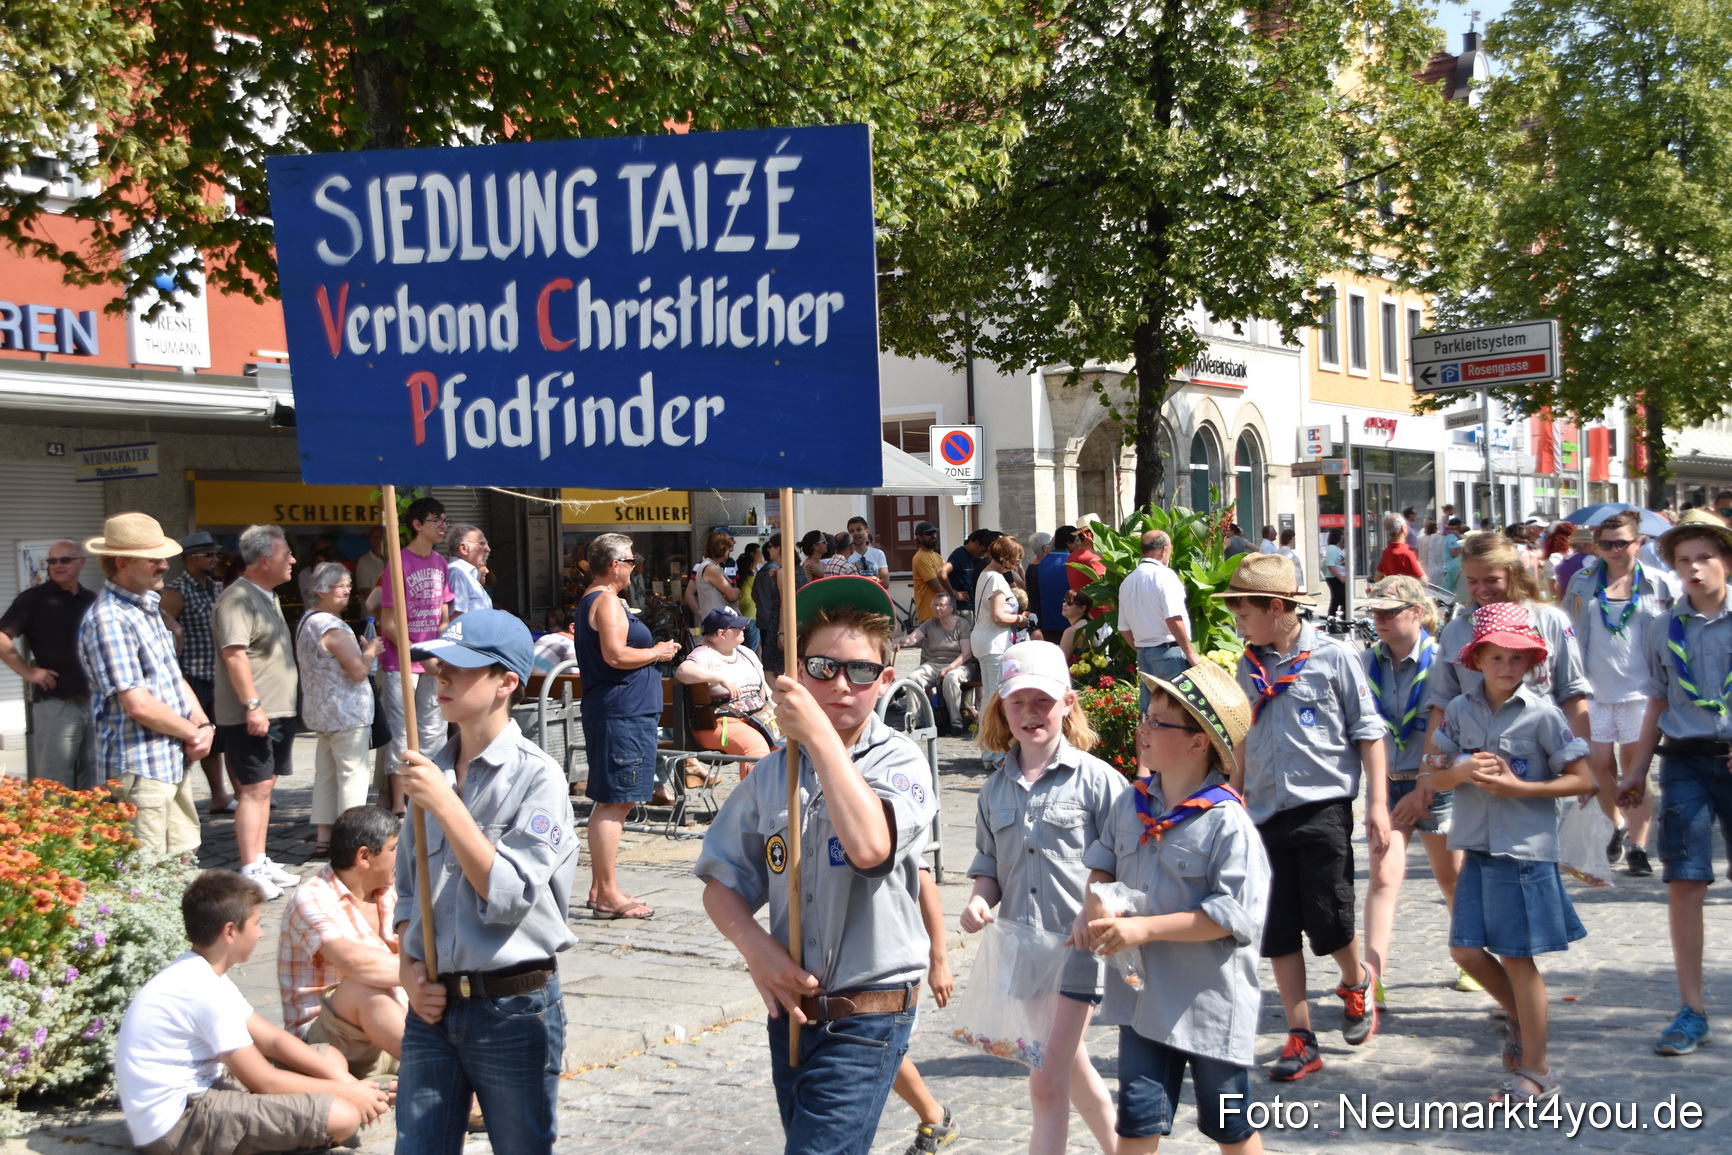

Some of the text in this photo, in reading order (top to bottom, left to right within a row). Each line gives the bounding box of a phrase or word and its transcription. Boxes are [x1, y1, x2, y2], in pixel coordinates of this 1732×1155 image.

[314, 136, 802, 267] SIEDLUNG TAIZÉ
[316, 273, 845, 359] Verband Christlicher
[145, 338, 201, 357] THUMANN
[1434, 333, 1526, 356] Parkleitsystem
[1468, 360, 1529, 377] Rosengasse
[405, 370, 726, 461] Pfadfinder
[48, 443, 64, 456] 41
[83, 448, 150, 466] NEUMARKTER
[944, 467, 971, 477] ZONE
[274, 504, 380, 522] SCHLIERF
[615, 506, 689, 521] SCHLIERF
